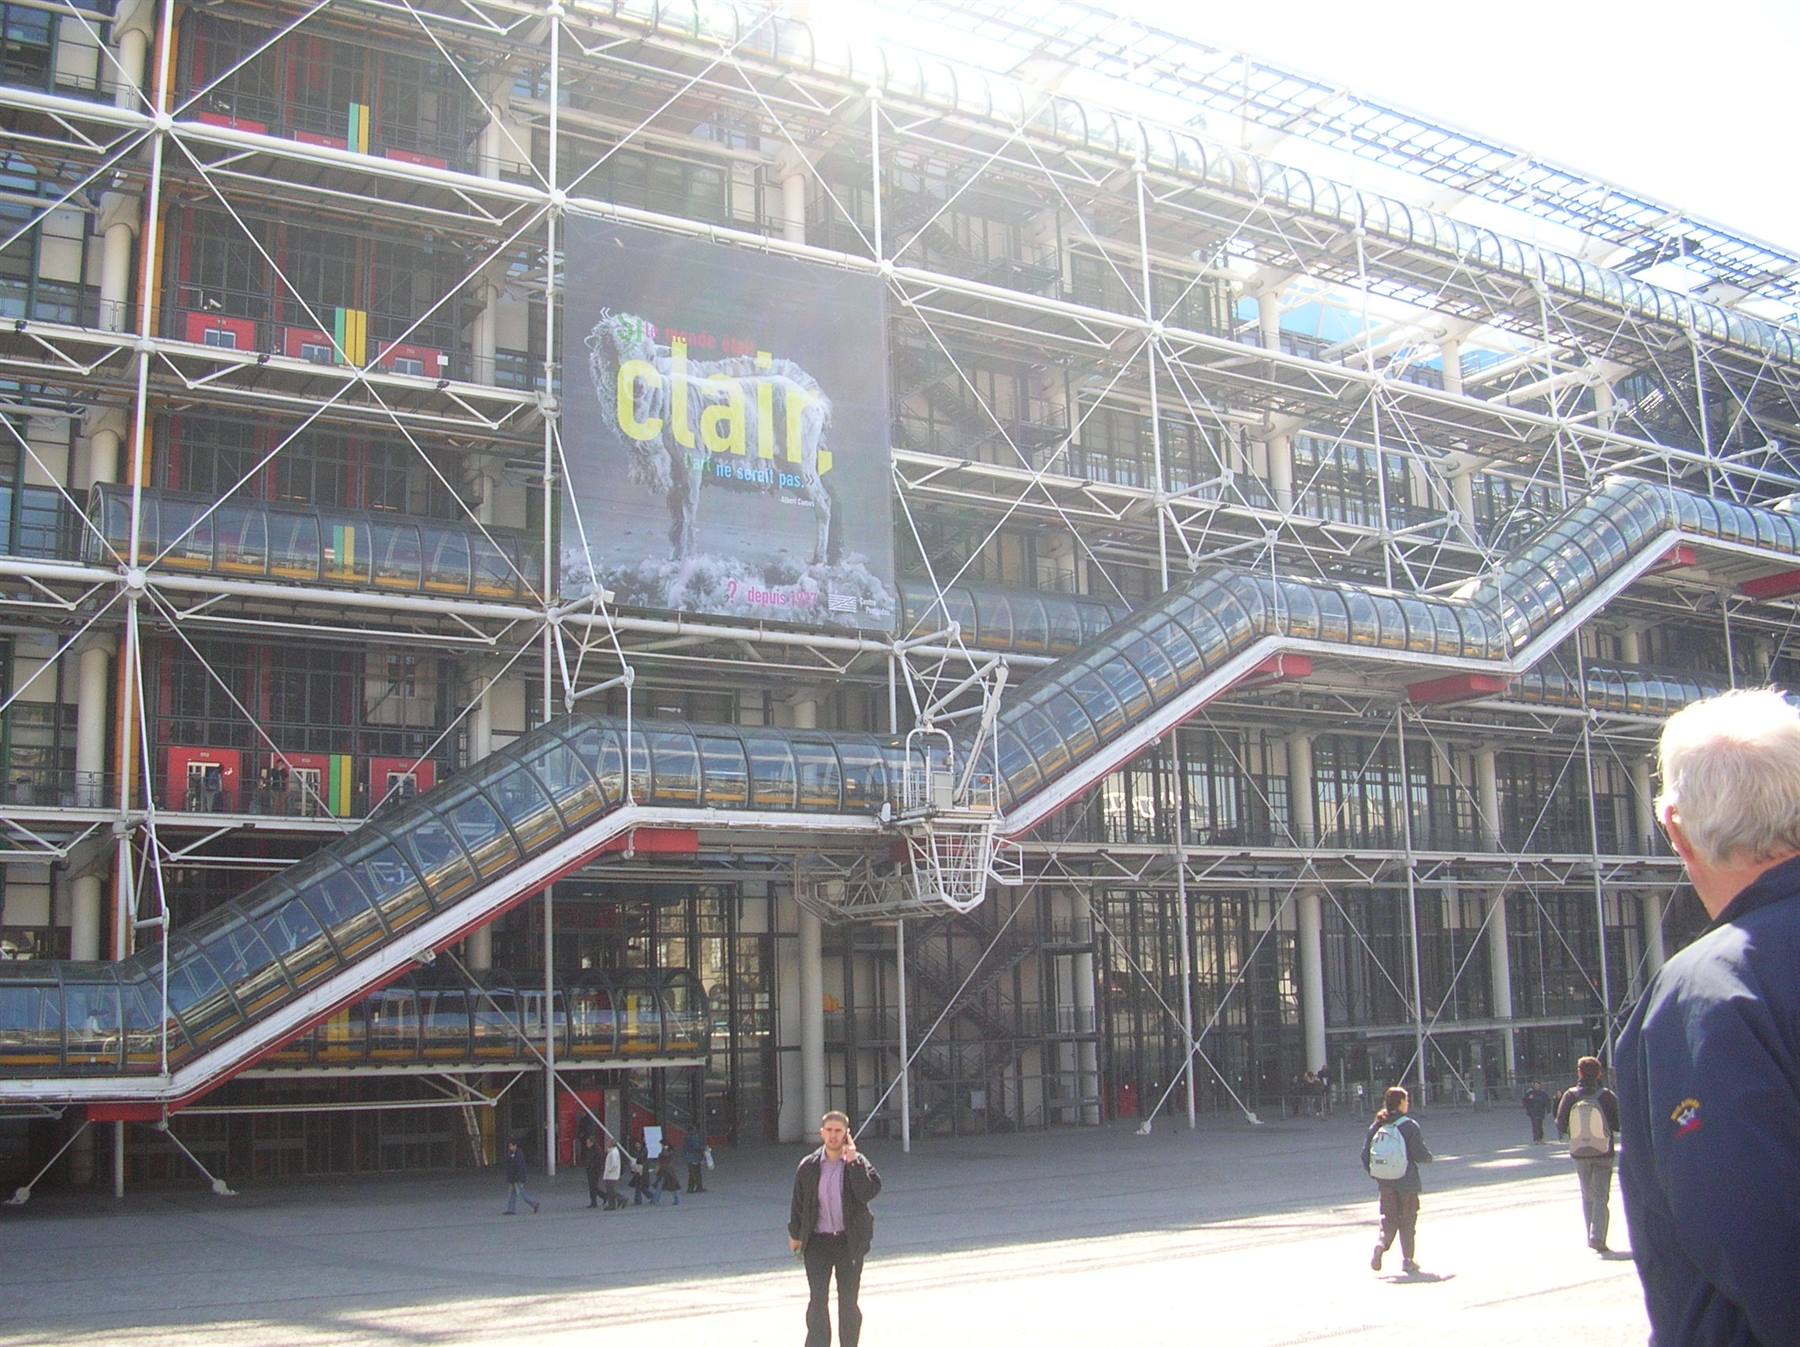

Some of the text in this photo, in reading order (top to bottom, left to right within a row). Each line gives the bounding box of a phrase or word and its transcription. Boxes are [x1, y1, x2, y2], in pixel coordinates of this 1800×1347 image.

[716, 463, 732, 478] ne
[737, 466, 774, 484] serait
[747, 586, 785, 607] depuis
